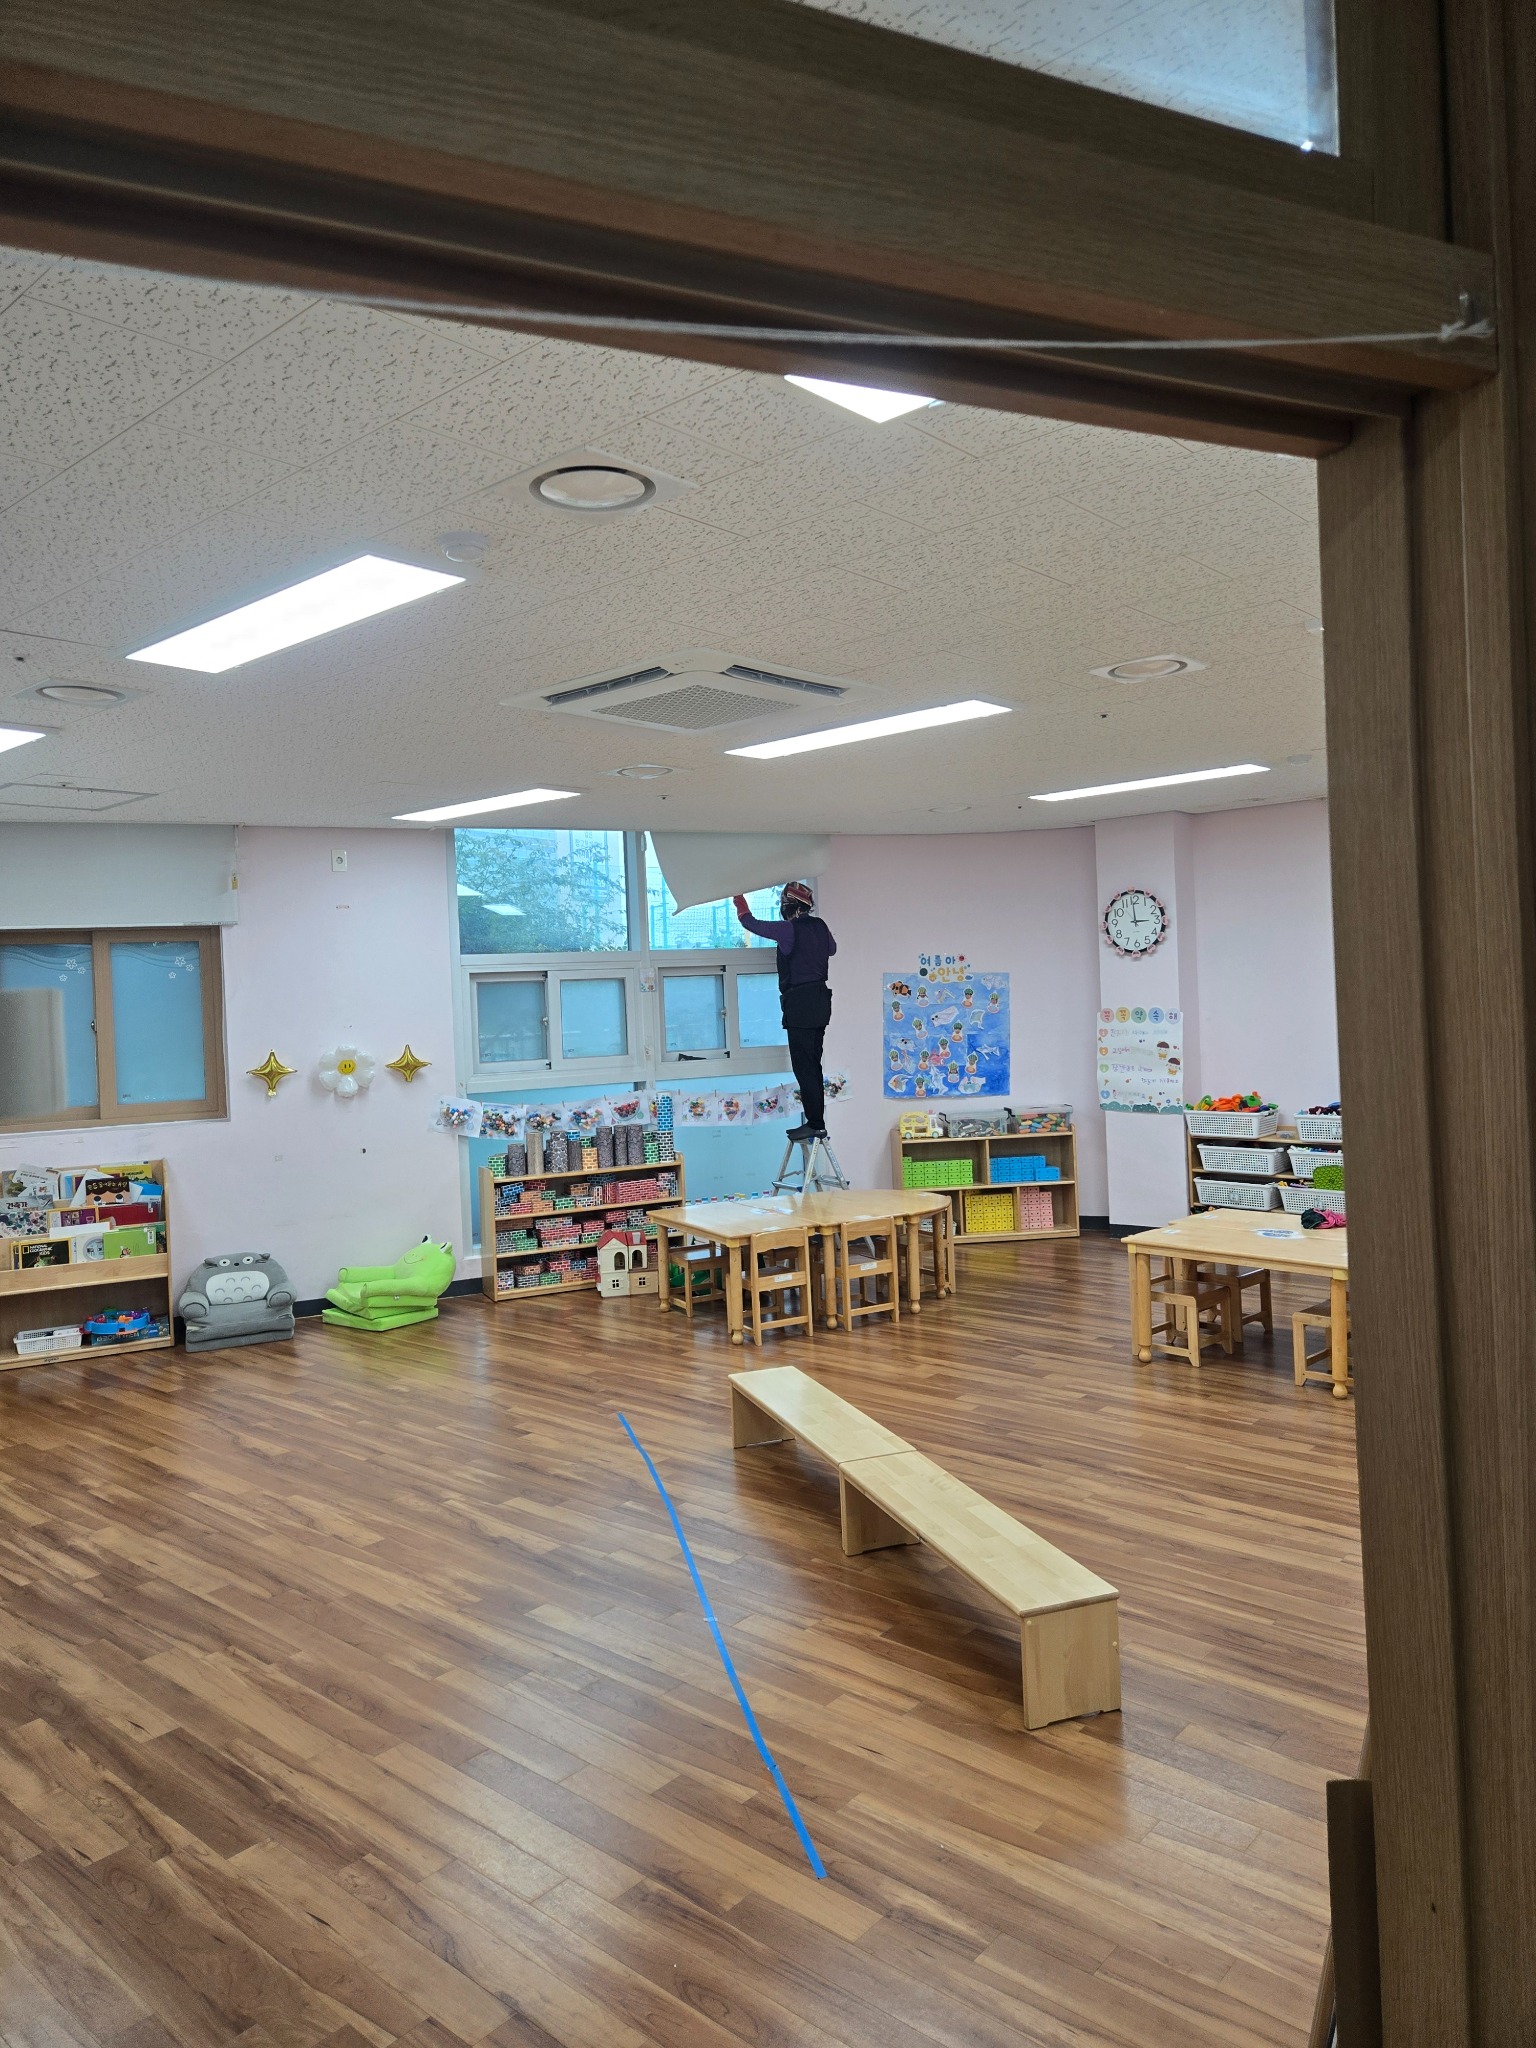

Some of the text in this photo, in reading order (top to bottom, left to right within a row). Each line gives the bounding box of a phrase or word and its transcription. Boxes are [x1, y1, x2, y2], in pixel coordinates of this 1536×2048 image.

[1122, 899, 1128, 908] 11
[1130, 895, 1139, 905] 12
[1114, 908, 1124, 918] 10
[1150, 905, 1157, 915] 2
[1111, 919, 1118, 927] 9
[1153, 915, 1160, 925] 3
[1116, 929, 1122, 939] 8
[1151, 927, 1157, 935] 4
[1124, 937, 1130, 946] 7
[1134, 939, 1140, 948] 6
[1144, 936, 1151, 945] 5
[937, 966, 965, 983] 안녕
[6, 1201, 28, 1210] 건축가
